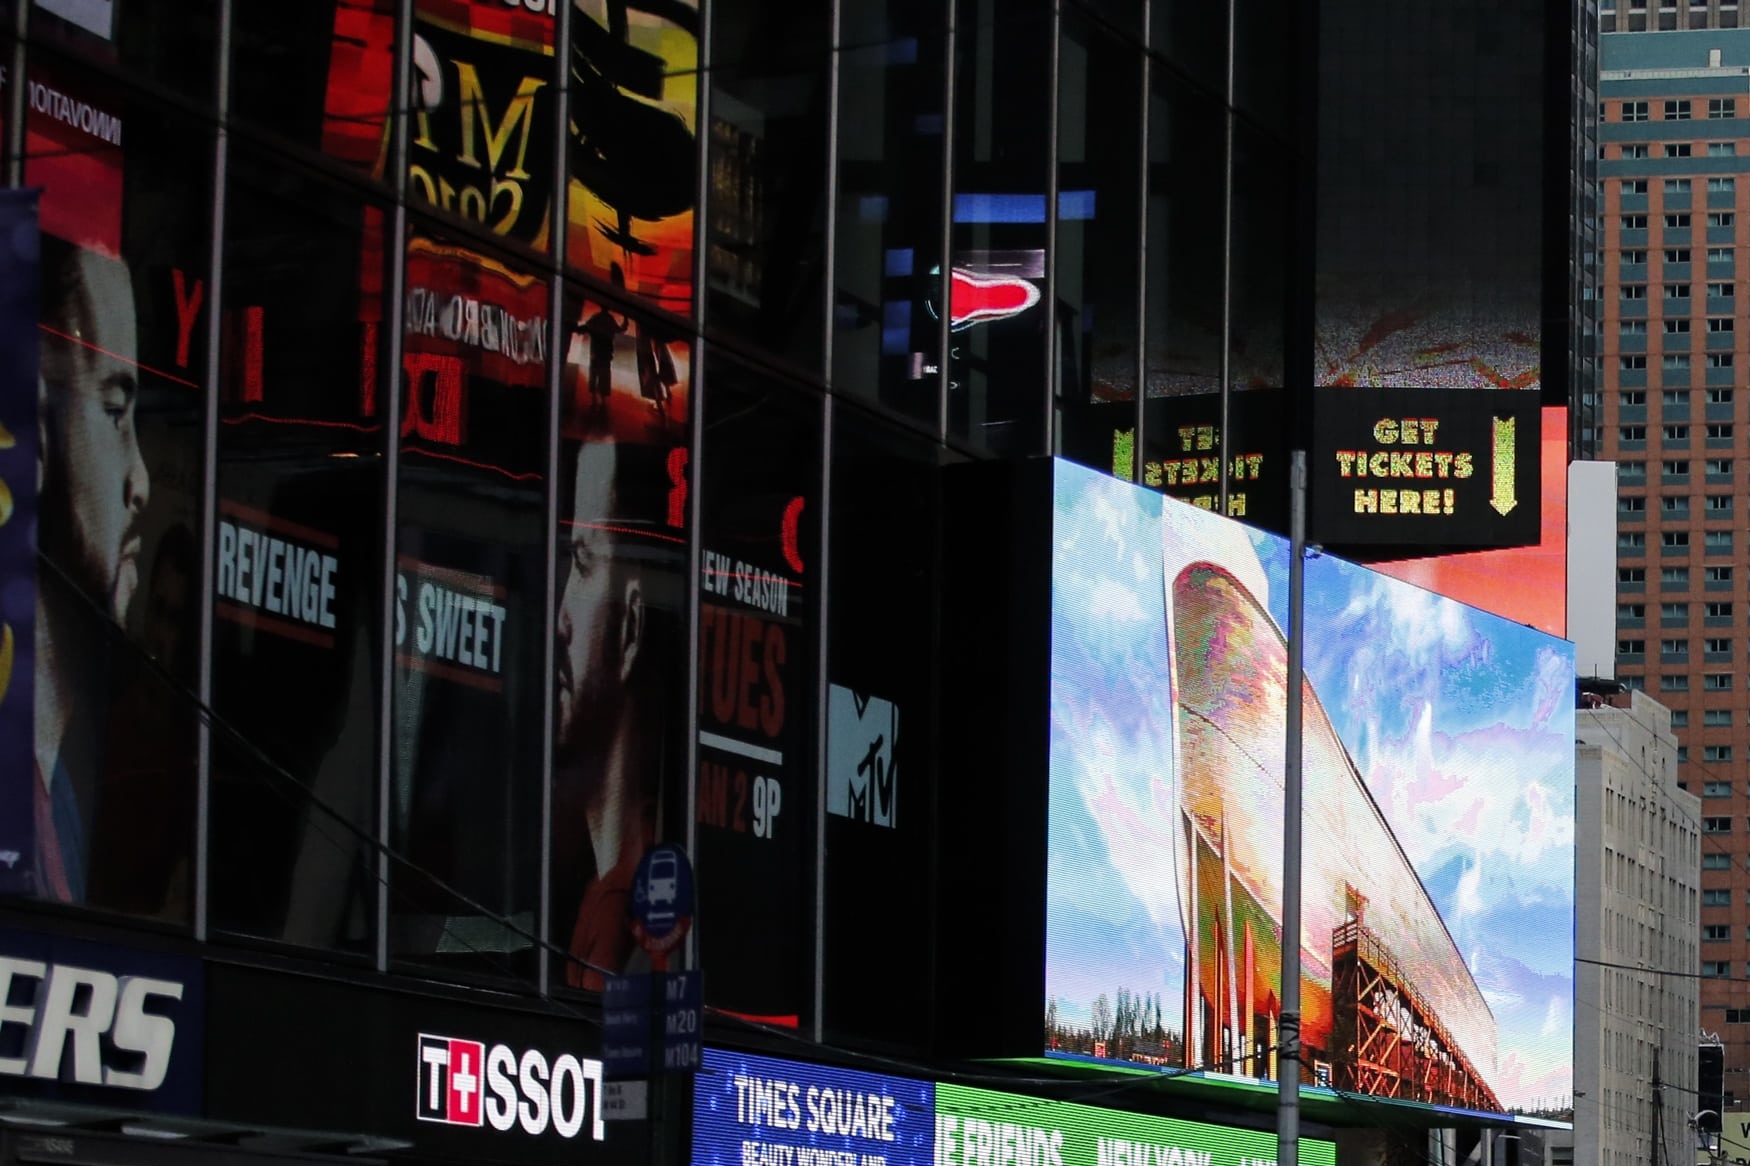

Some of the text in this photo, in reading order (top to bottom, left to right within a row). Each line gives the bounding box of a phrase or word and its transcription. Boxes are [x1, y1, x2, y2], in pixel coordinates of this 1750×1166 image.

[1372, 416, 1440, 445] GET
[1336, 450, 1475, 479] TICKETS
[1353, 487, 1456, 515] HERE!
[217, 520, 339, 630] REVENGE
[702, 549, 789, 618] EW SEASON
[418, 581, 506, 674] SWEET
[752, 775, 782, 840] 9P
[665, 1009, 697, 1035] M20
[664, 1044, 699, 1069] M104
[734, 1073, 896, 1142] TIMES SQUARE
